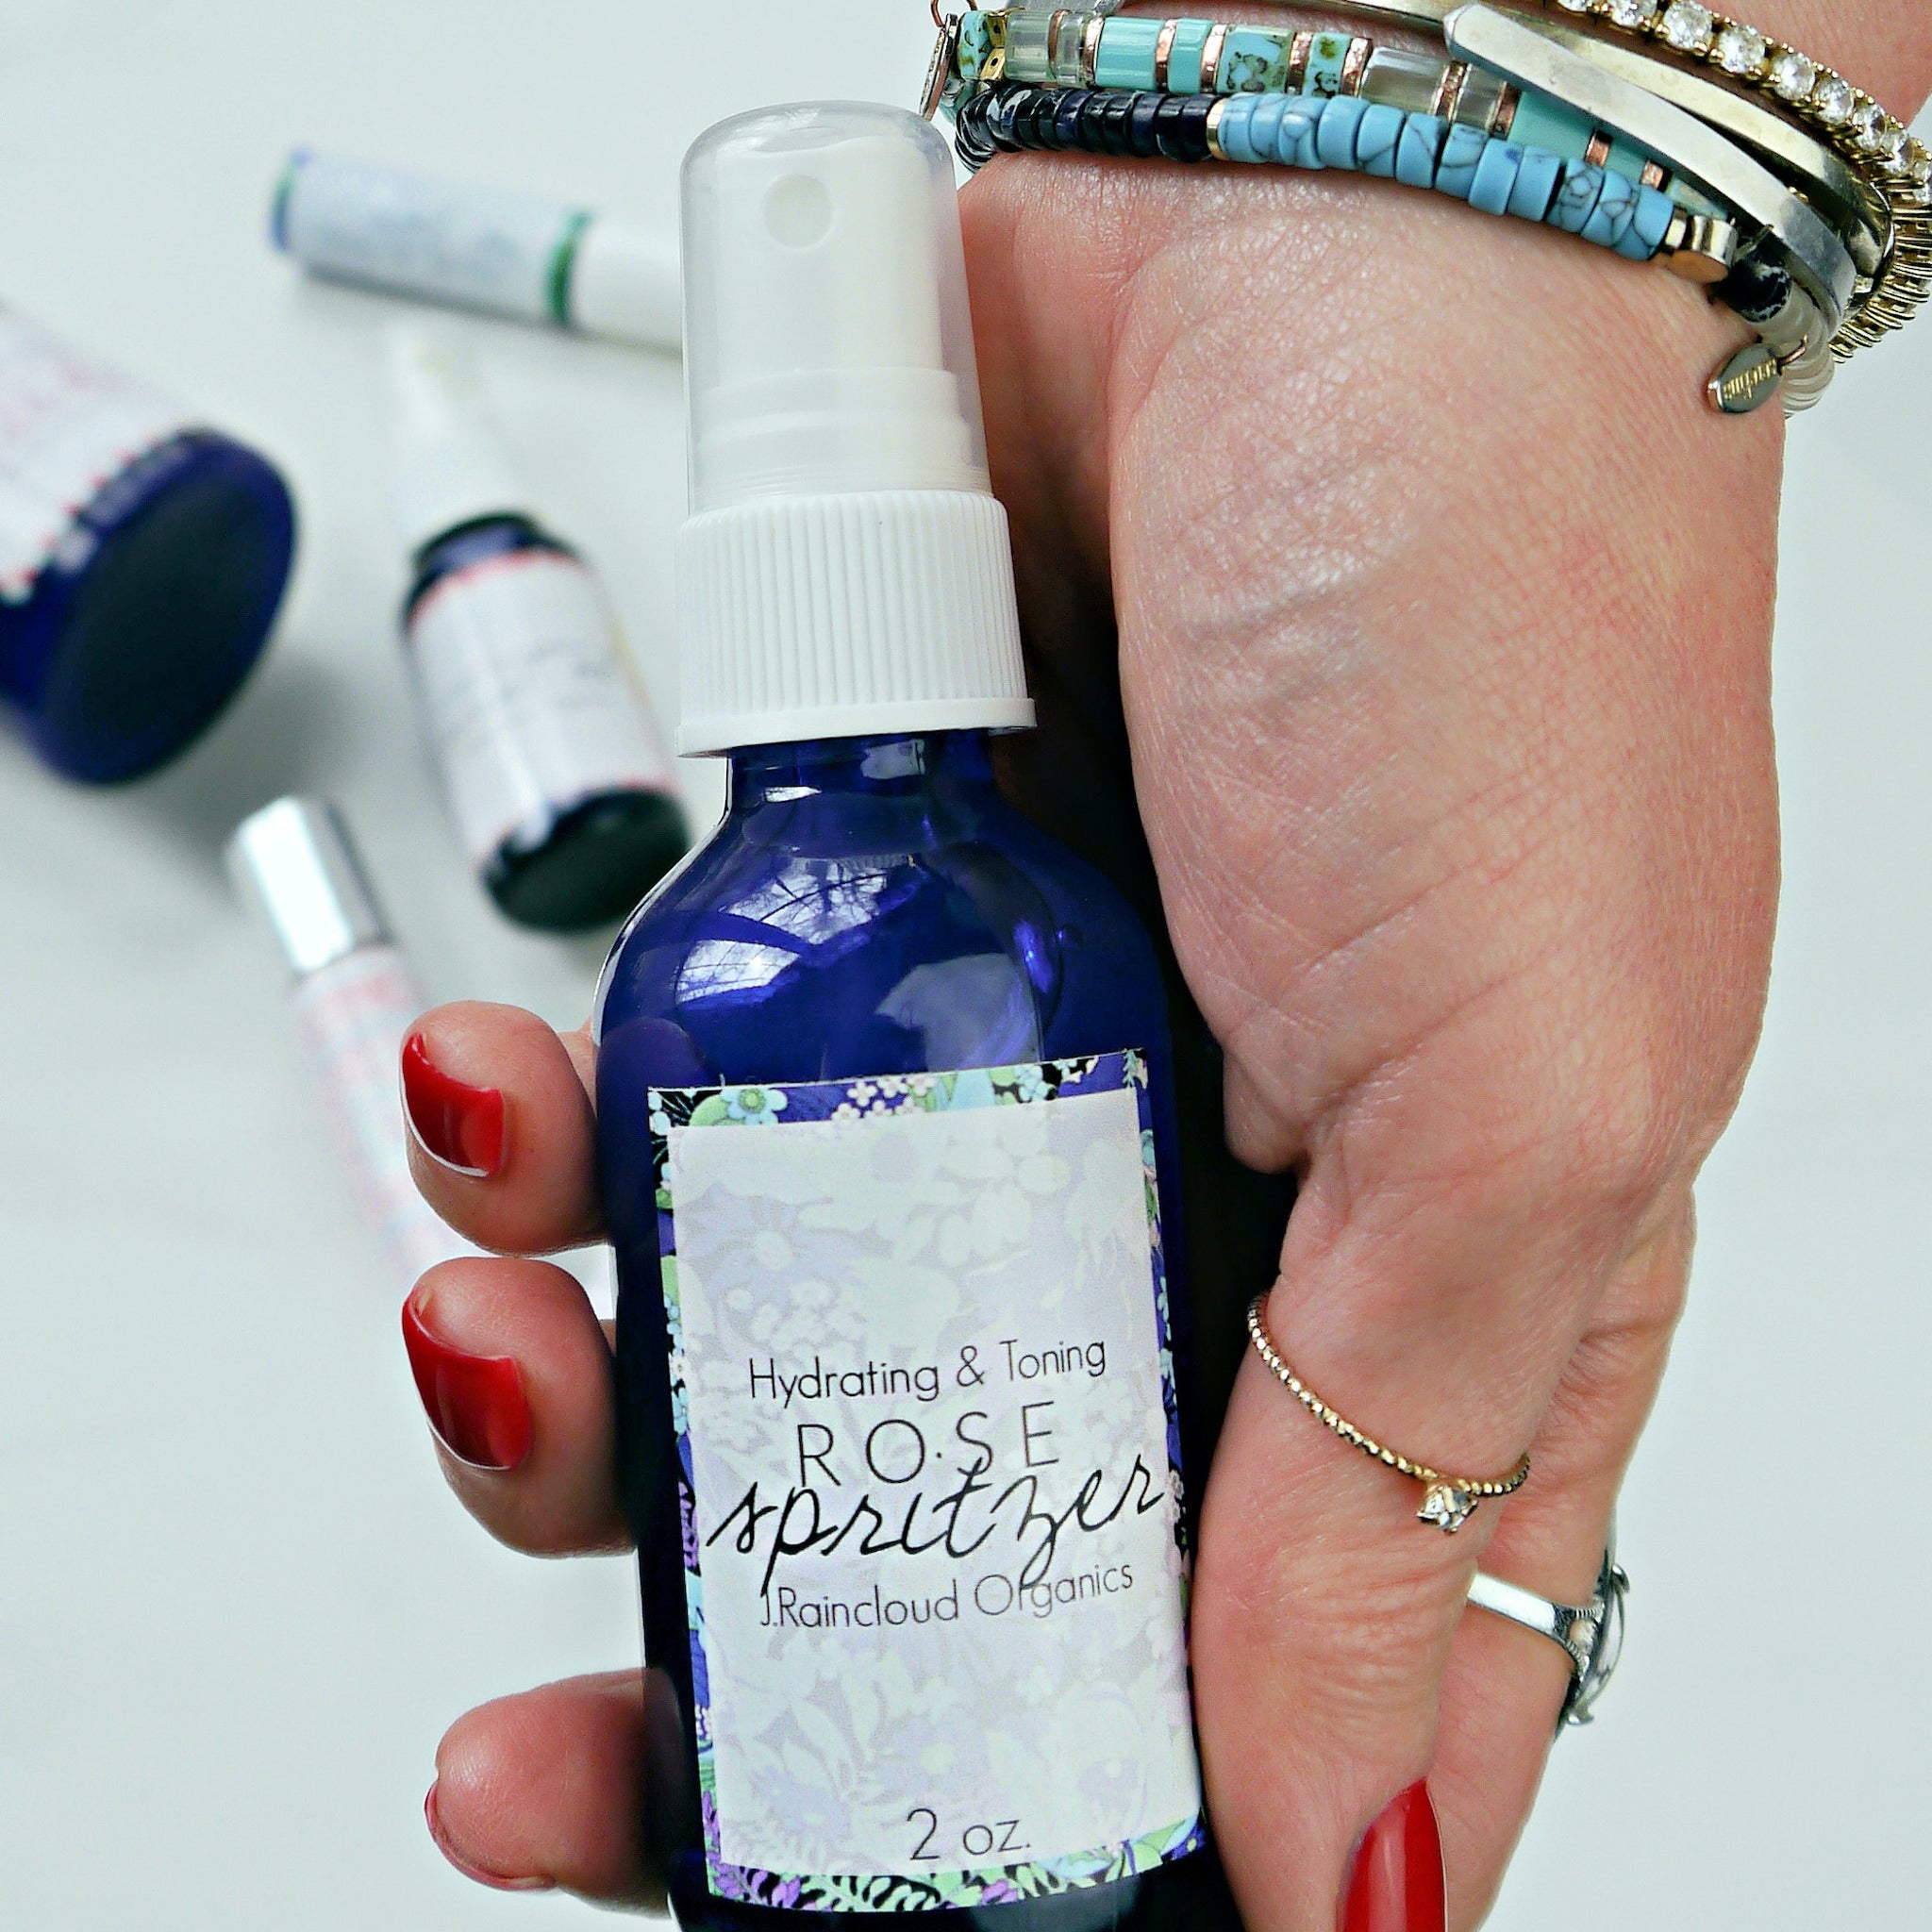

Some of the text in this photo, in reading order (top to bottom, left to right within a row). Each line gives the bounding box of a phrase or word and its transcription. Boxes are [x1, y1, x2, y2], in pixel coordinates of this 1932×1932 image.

[749, 1338, 1107, 1409] Hydrating & Toning
[796, 1400, 1060, 1488] ROSE
[706, 1453, 1165, 1598] spritzer
[974, 1564, 1134, 1619] Organics
[906, 1807, 1032, 1861] 2 oz.
